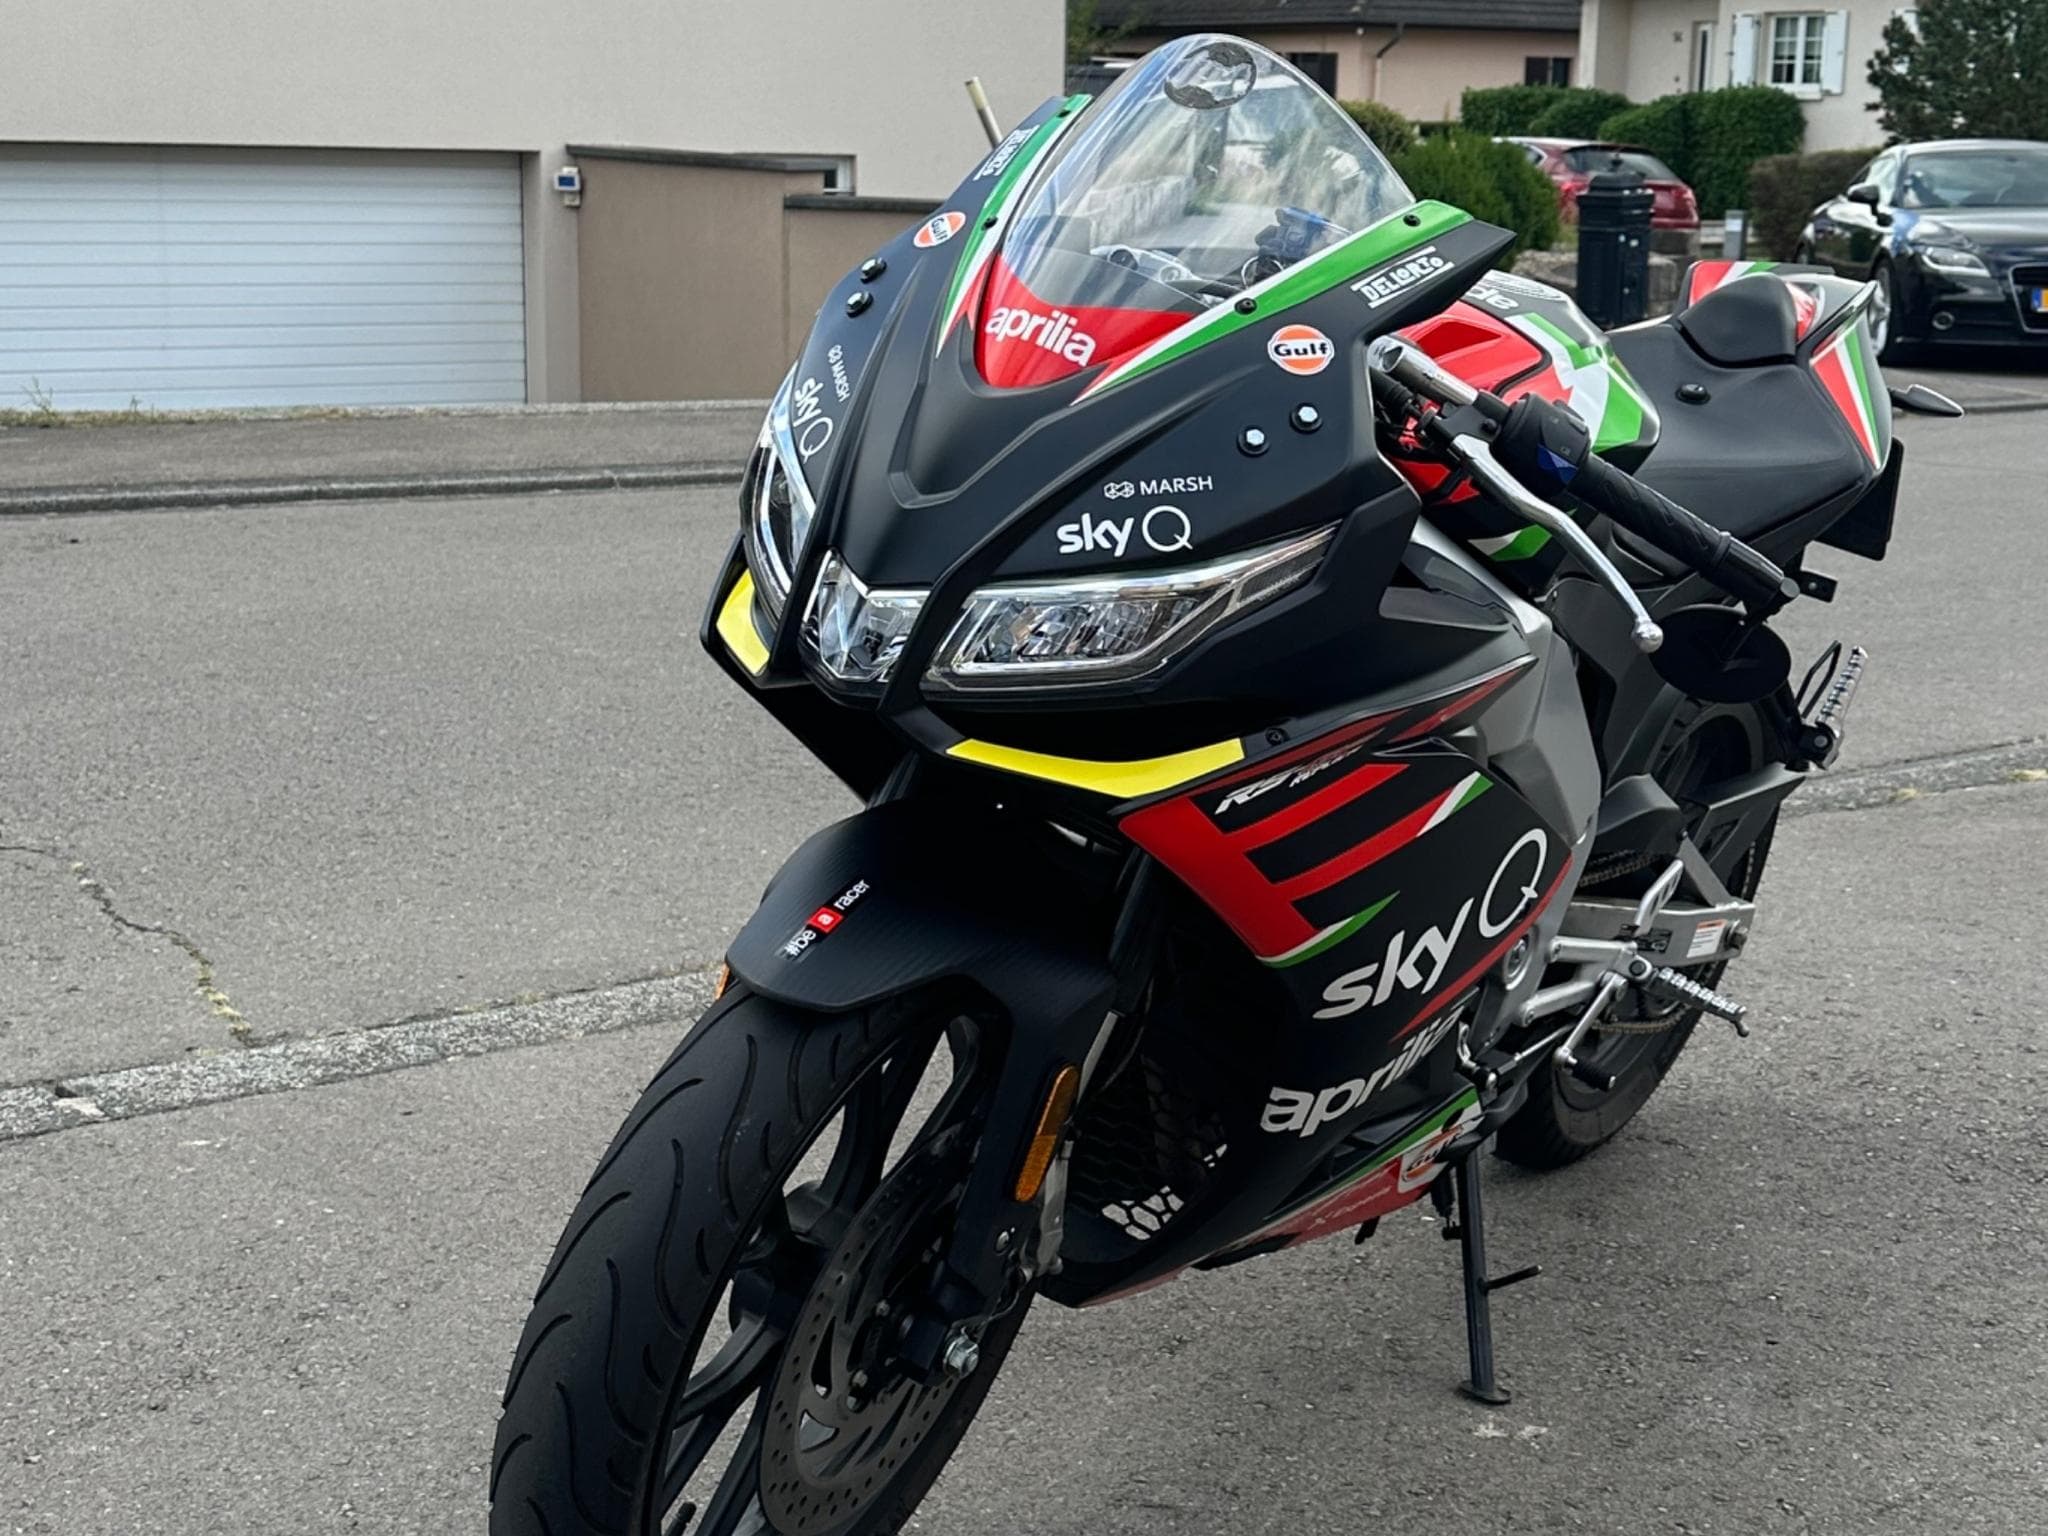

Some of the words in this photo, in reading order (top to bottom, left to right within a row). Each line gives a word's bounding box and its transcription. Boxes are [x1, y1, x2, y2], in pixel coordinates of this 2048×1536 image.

[985, 307, 1097, 368] aprilia
[1274, 342, 1329, 357] Gulf
[793, 377, 824, 428] sky
[831, 360, 851, 403] MARSH
[799, 416, 834, 465] Q
[1139, 475, 1214, 496] MARSH
[1056, 512, 1135, 557] sky
[1142, 505, 1194, 552] Q
[784, 930, 817, 957] #be
[817, 913, 835, 926] a
[833, 879, 870, 911] racer
[1312, 897, 1475, 1020] sky
[1478, 828, 1548, 938] Q
[1259, 1005, 1465, 1138] aprilia
